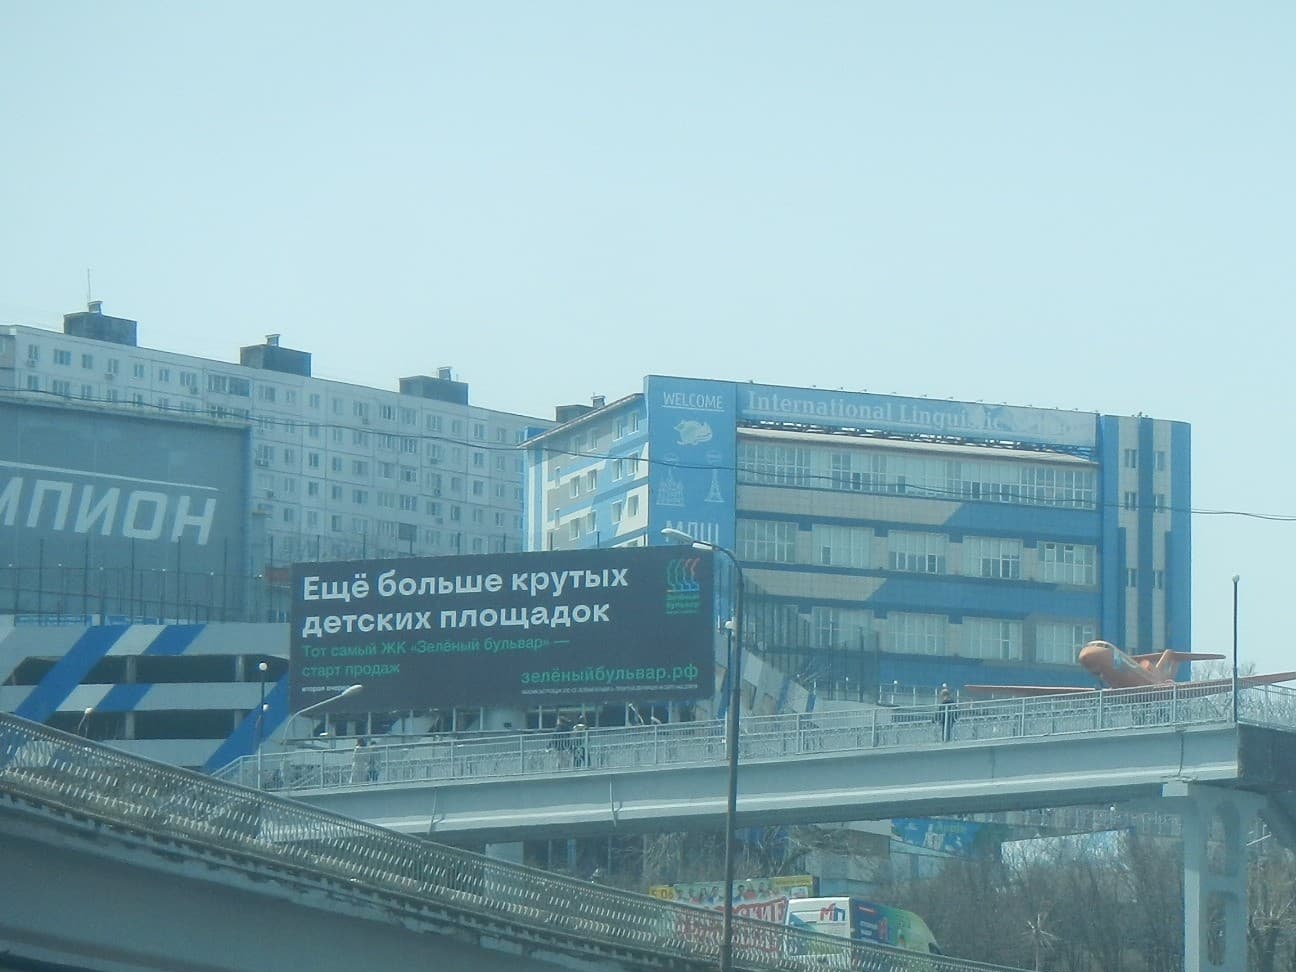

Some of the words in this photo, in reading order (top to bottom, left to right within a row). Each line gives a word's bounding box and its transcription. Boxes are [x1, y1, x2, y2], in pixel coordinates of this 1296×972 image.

[663, 391, 723, 410] WELCOME
[749, 390, 892, 420] International
[303, 573, 370, 602] Ещё
[378, 569, 503, 597] больше
[512, 568, 629, 597] крутых
[302, 611, 432, 638] детских
[440, 603, 610, 629] площадок
[303, 644, 328, 658] Тот
[331, 642, 377, 656] самый
[382, 642, 407, 655] ЖК
[302, 665, 340, 679] старт
[345, 662, 400, 678] продаж
[521, 663, 699, 684] зелёныйбульвар.рф
